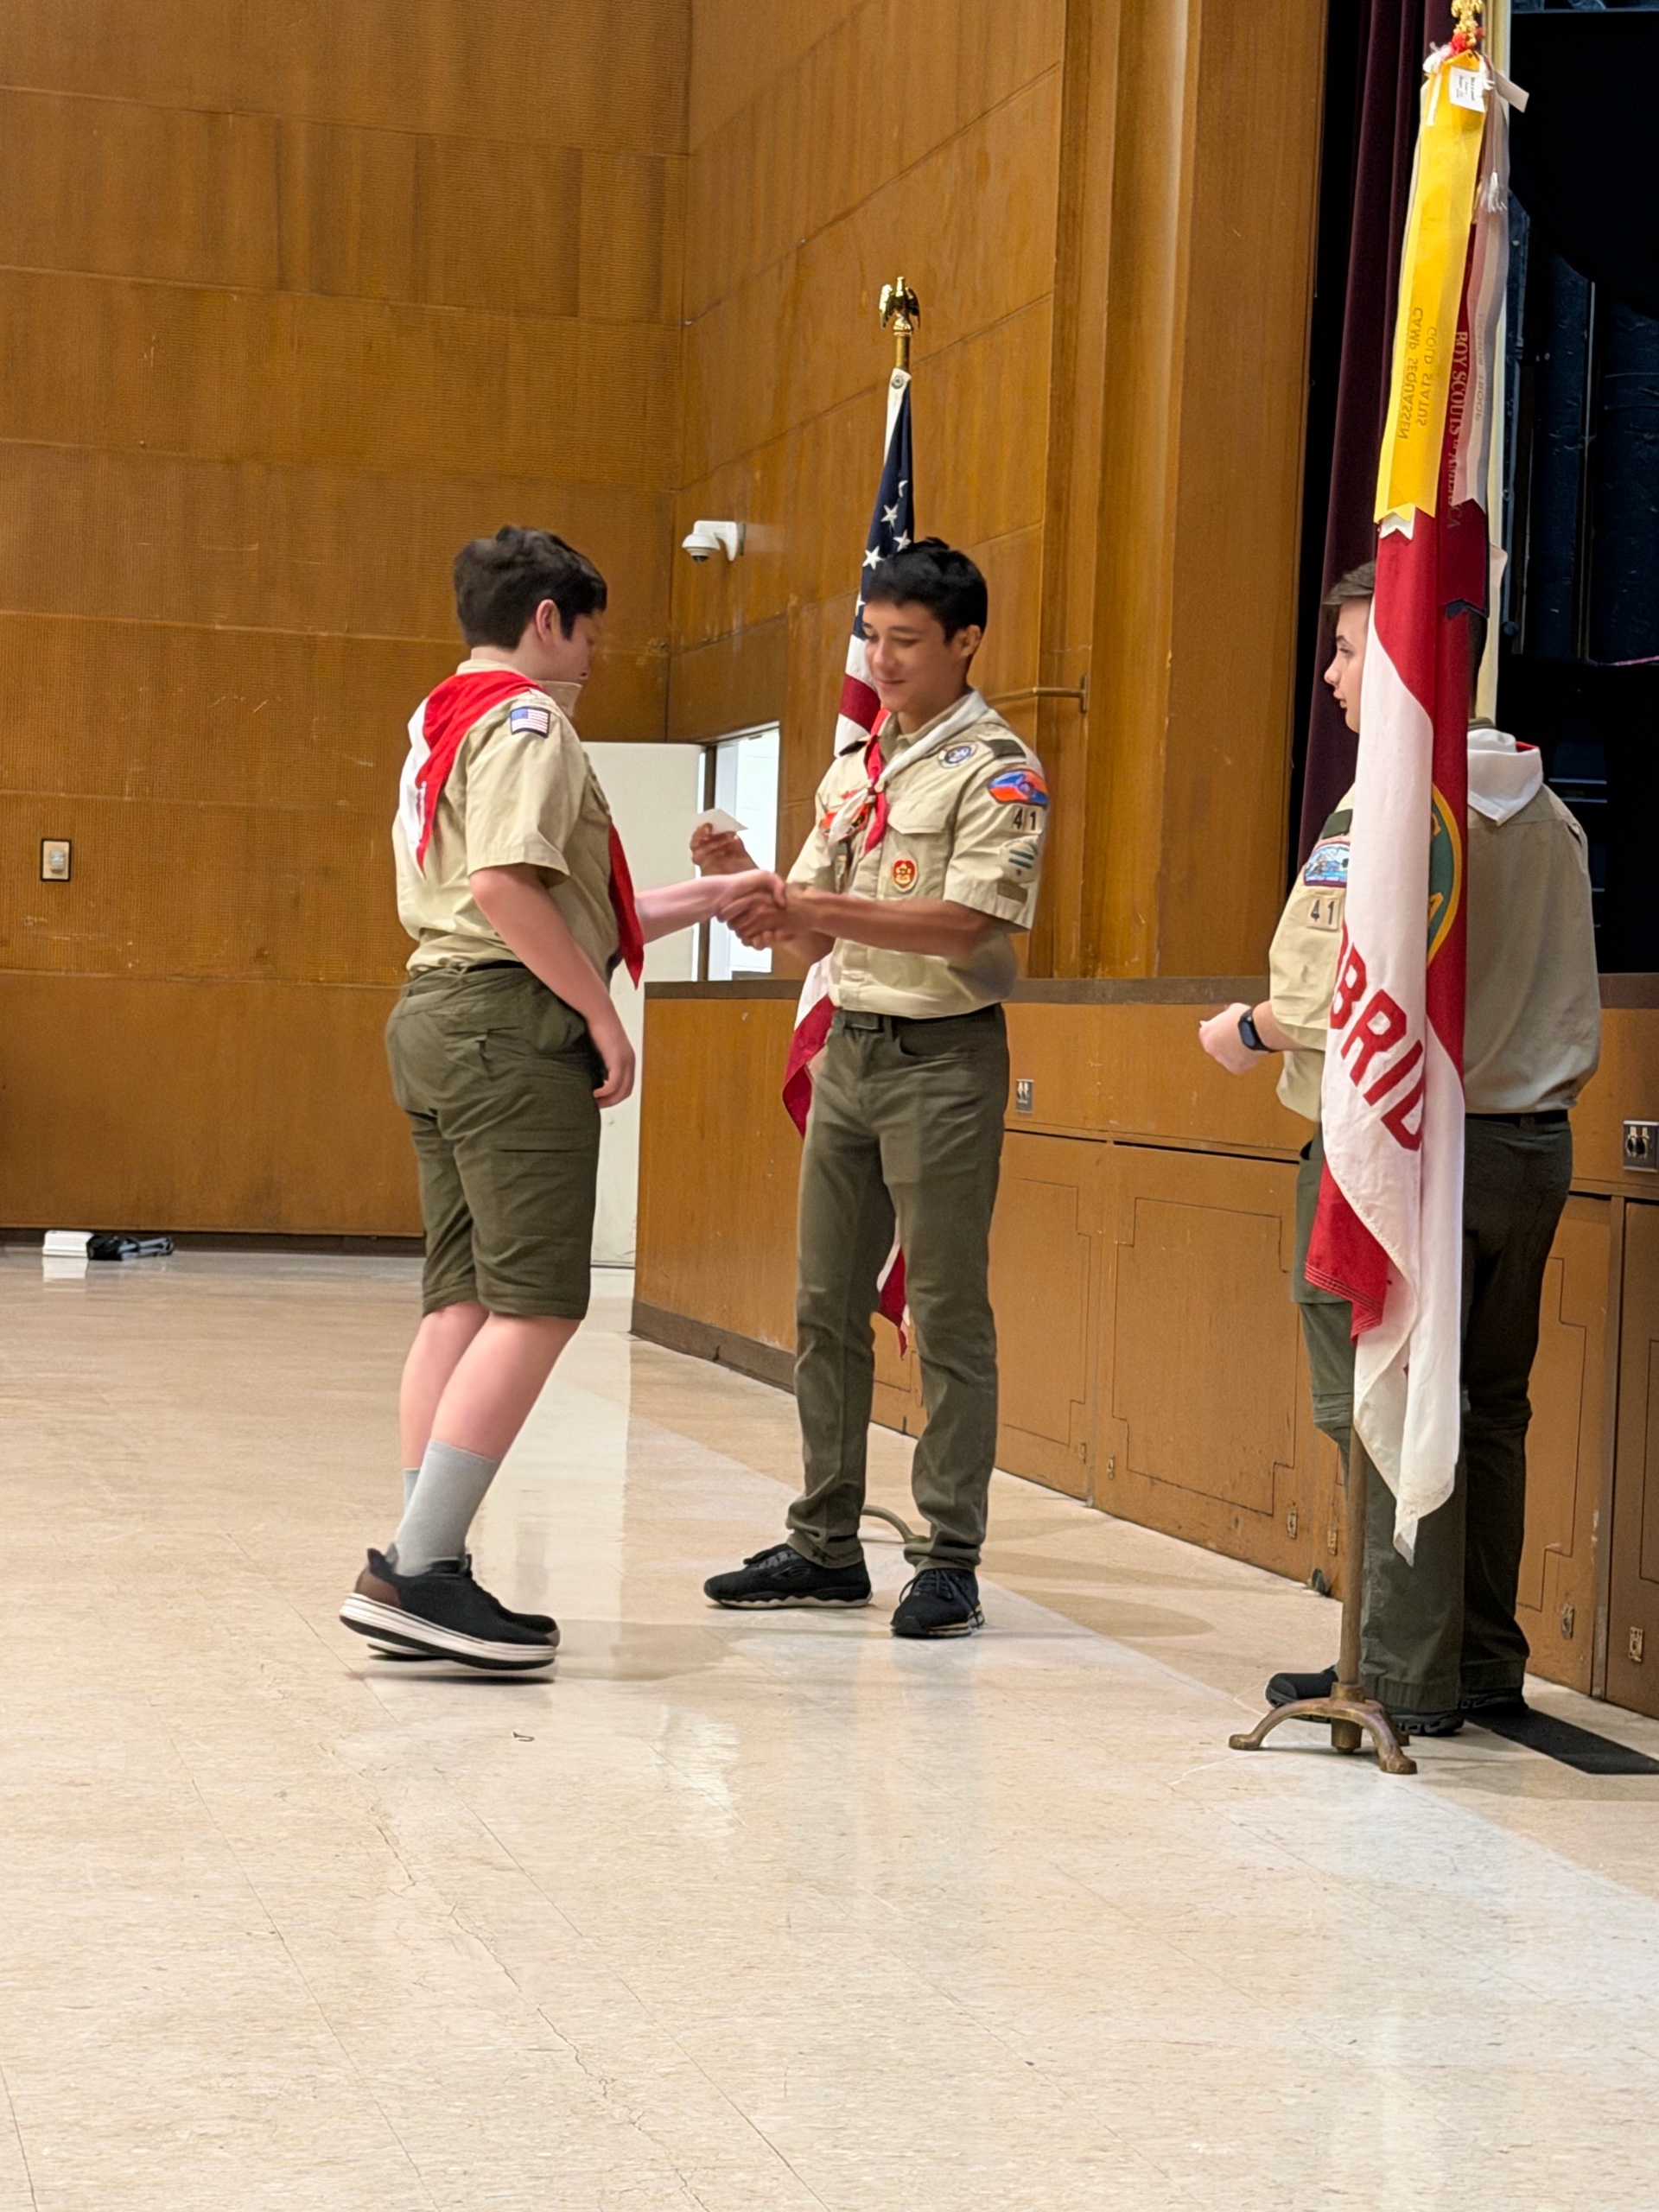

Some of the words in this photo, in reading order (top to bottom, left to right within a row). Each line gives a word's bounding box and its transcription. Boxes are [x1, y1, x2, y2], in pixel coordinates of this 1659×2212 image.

[1453, 330, 1468, 369] BOY
[1448, 371, 1468, 437] SCOUTS
[1013, 808, 1037, 830] 41
[1310, 899, 1335, 925] 41
